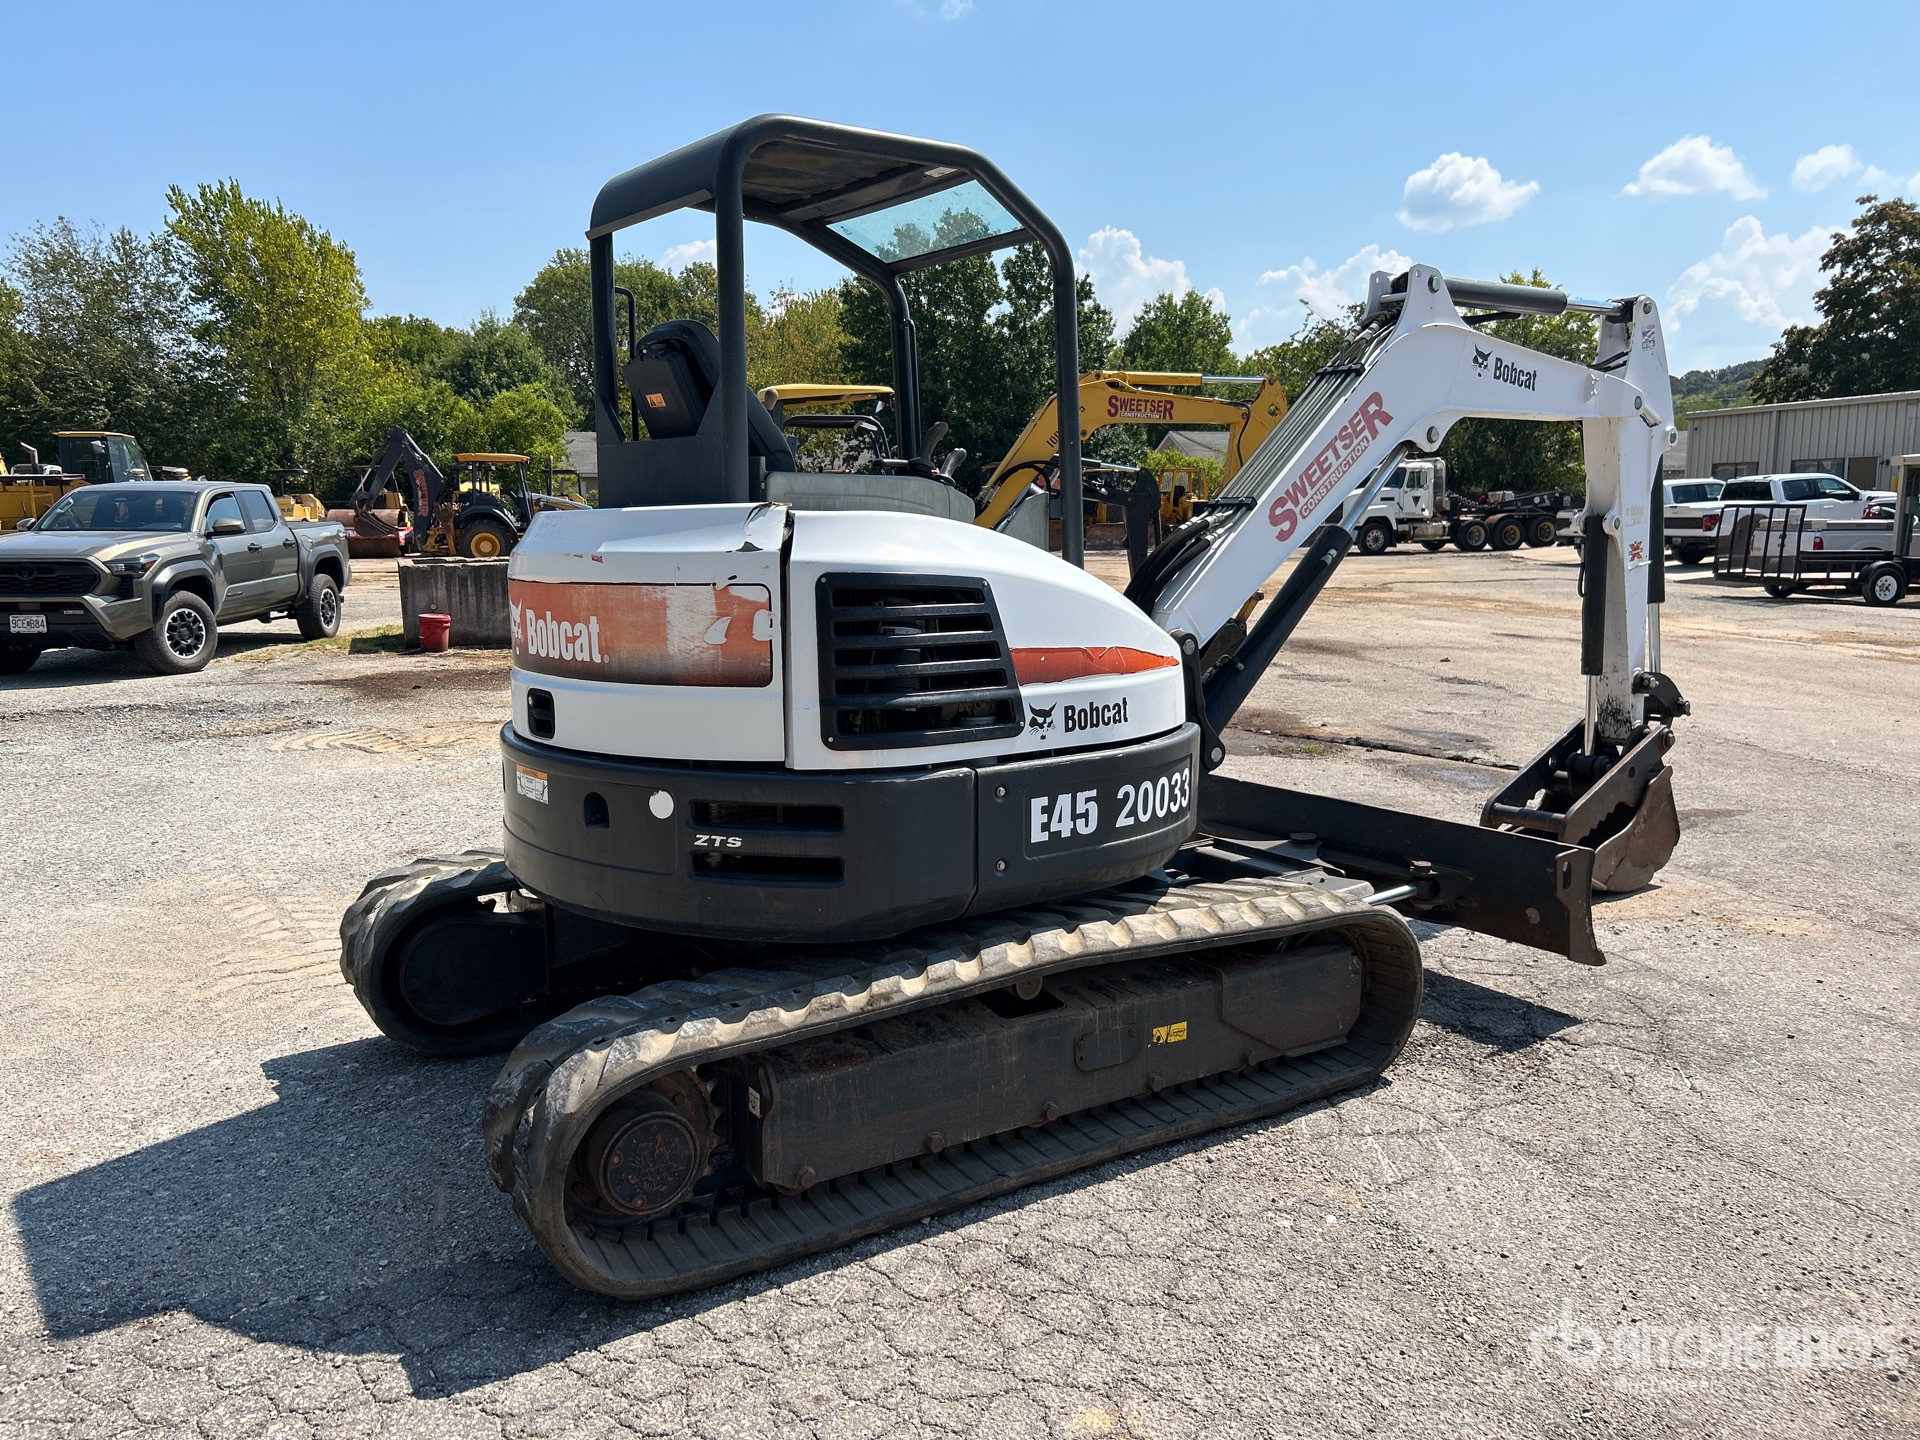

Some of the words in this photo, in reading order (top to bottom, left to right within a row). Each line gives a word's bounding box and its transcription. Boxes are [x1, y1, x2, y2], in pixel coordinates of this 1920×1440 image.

[1494, 356, 1537, 391] Bobcat
[1107, 394, 1175, 420] SWEETSER
[1120, 411, 1161, 419] CONSTRUCTION
[1268, 391, 1394, 542] SWEETSER
[1301, 438, 1370, 518] CONSTRUCTION
[525, 608, 602, 663] Bobcat
[1063, 696, 1129, 733] Bobcat
[1030, 788, 1098, 843] E45
[1115, 767, 1190, 828] 20033
[693, 834, 743, 849] ZTS
